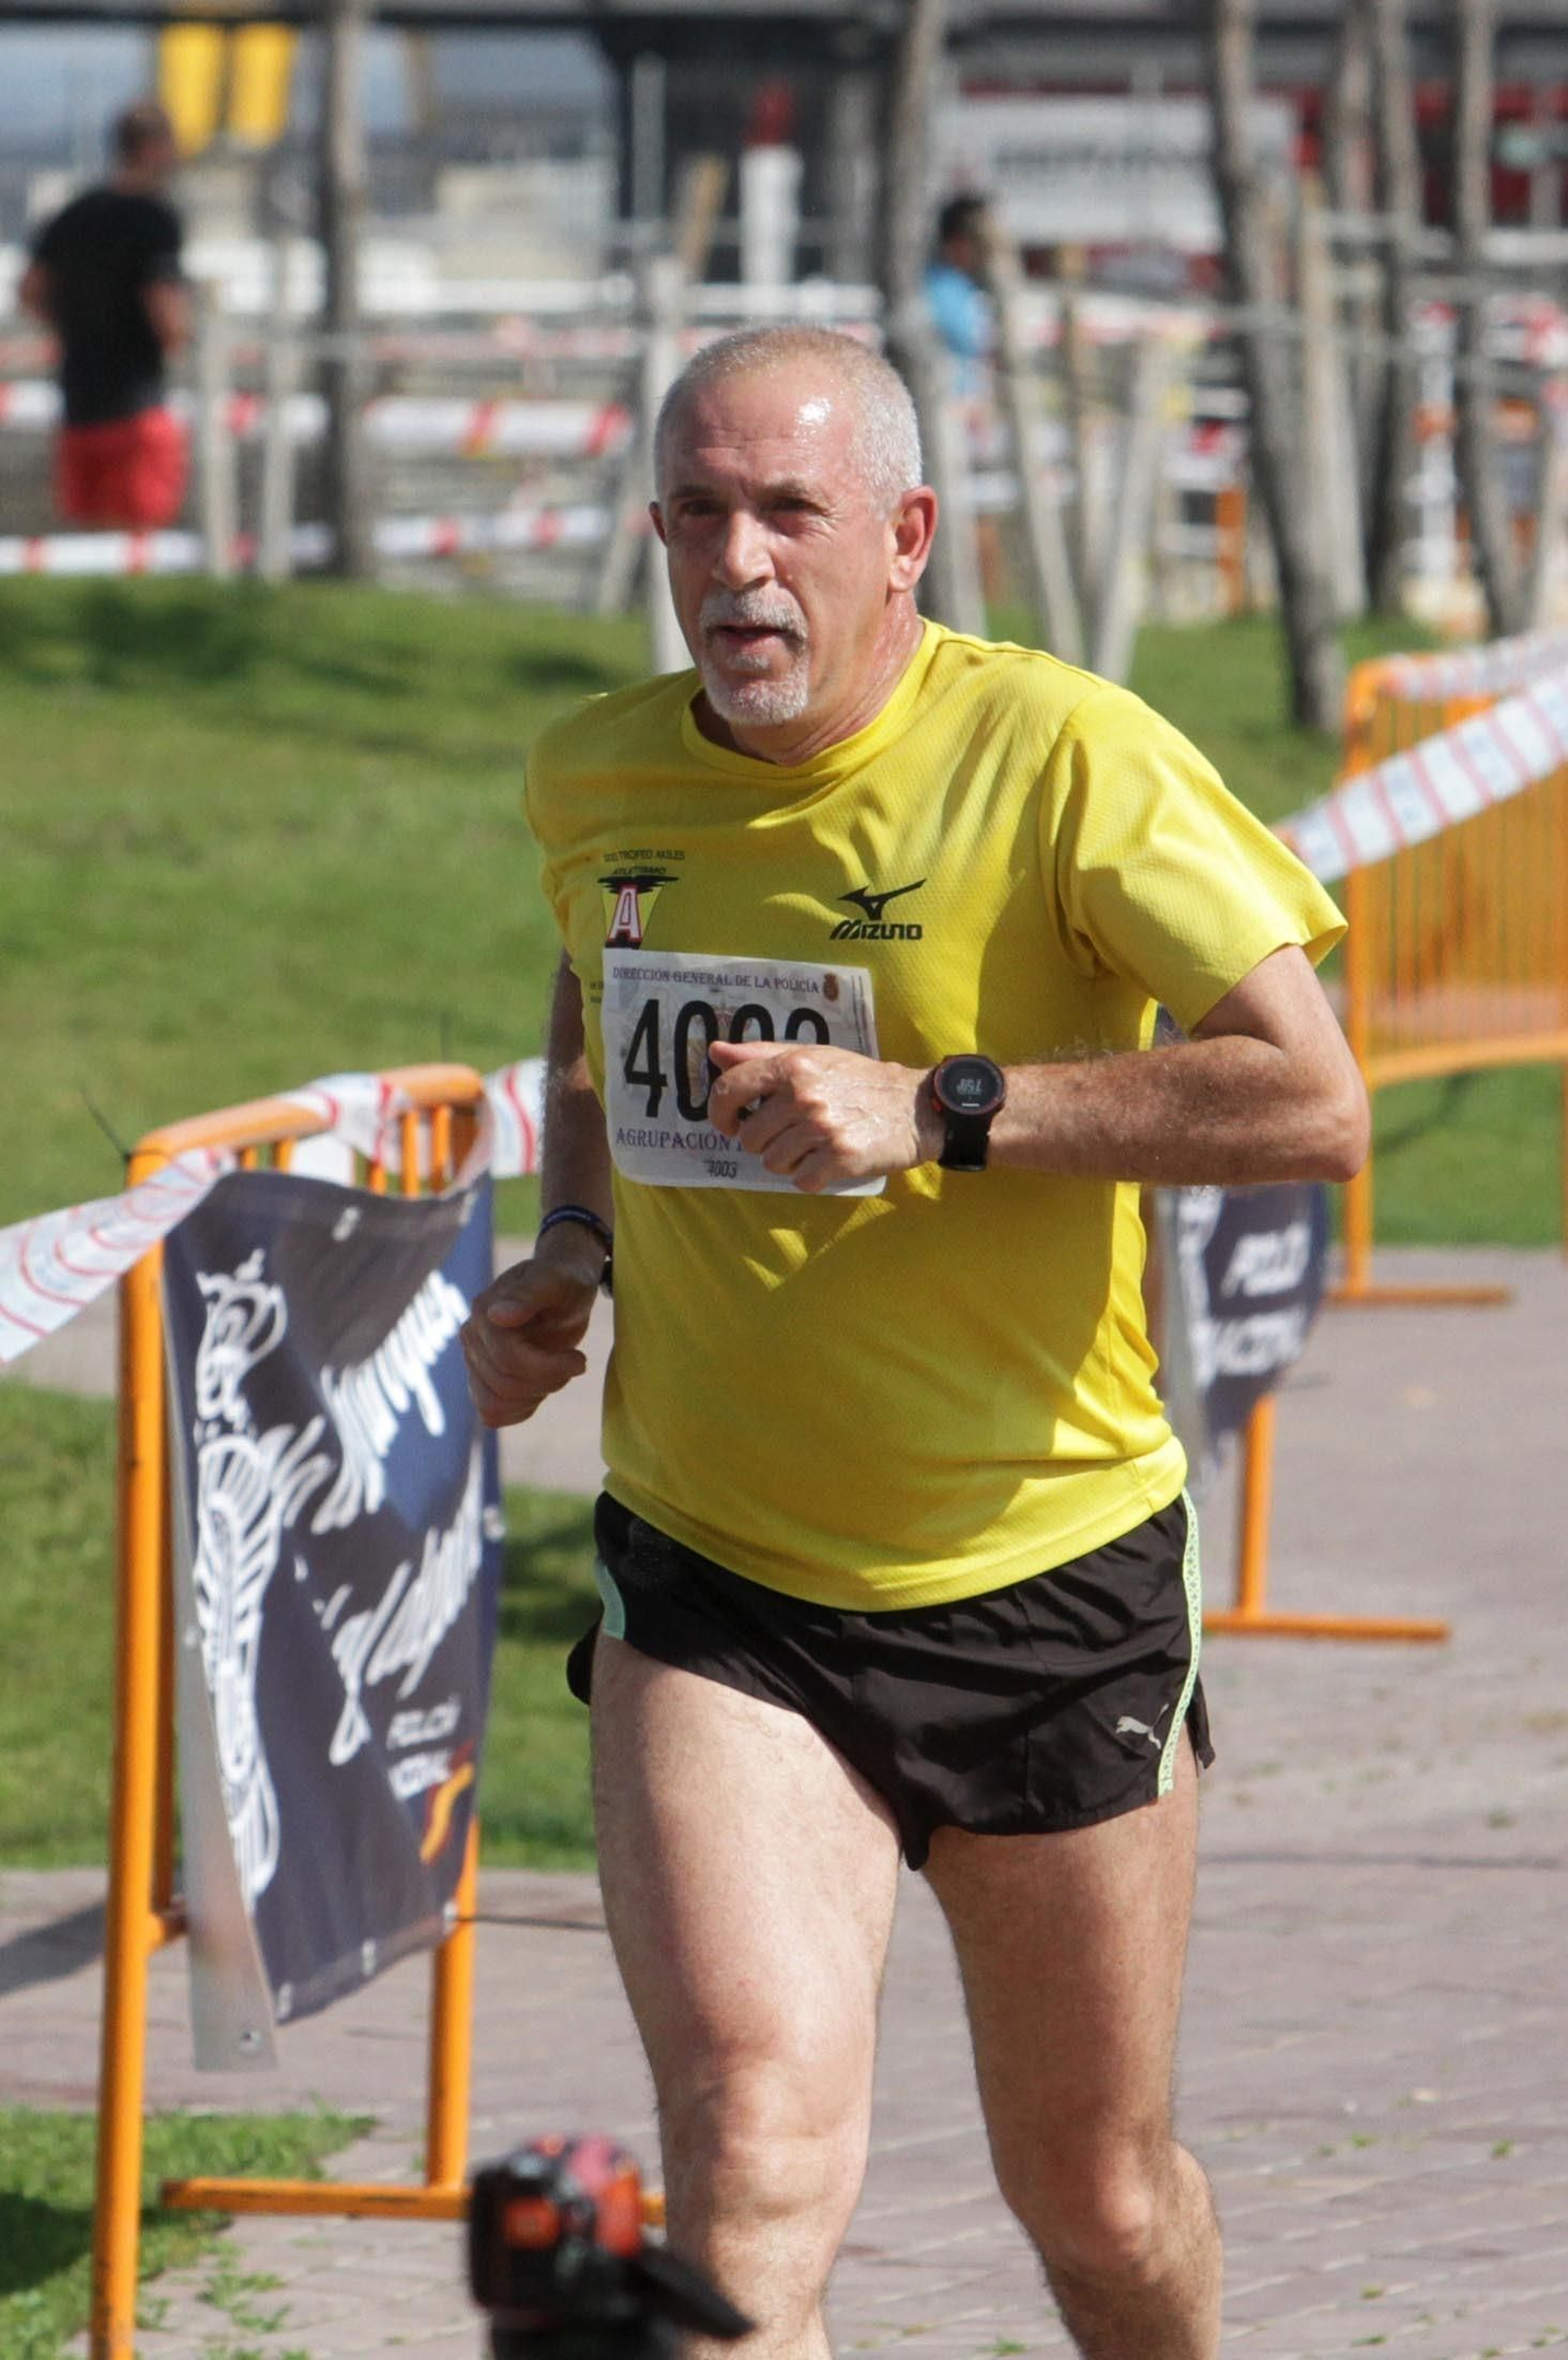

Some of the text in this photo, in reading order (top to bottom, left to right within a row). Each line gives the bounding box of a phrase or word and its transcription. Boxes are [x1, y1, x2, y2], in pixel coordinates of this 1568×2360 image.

[618, 850, 653, 860] TROFEO
[656, 850, 685, 860] AKILES
[672, 969, 732, 986] GENERAL
[735, 974, 752, 988] DE
[754, 976, 771, 990] LA
